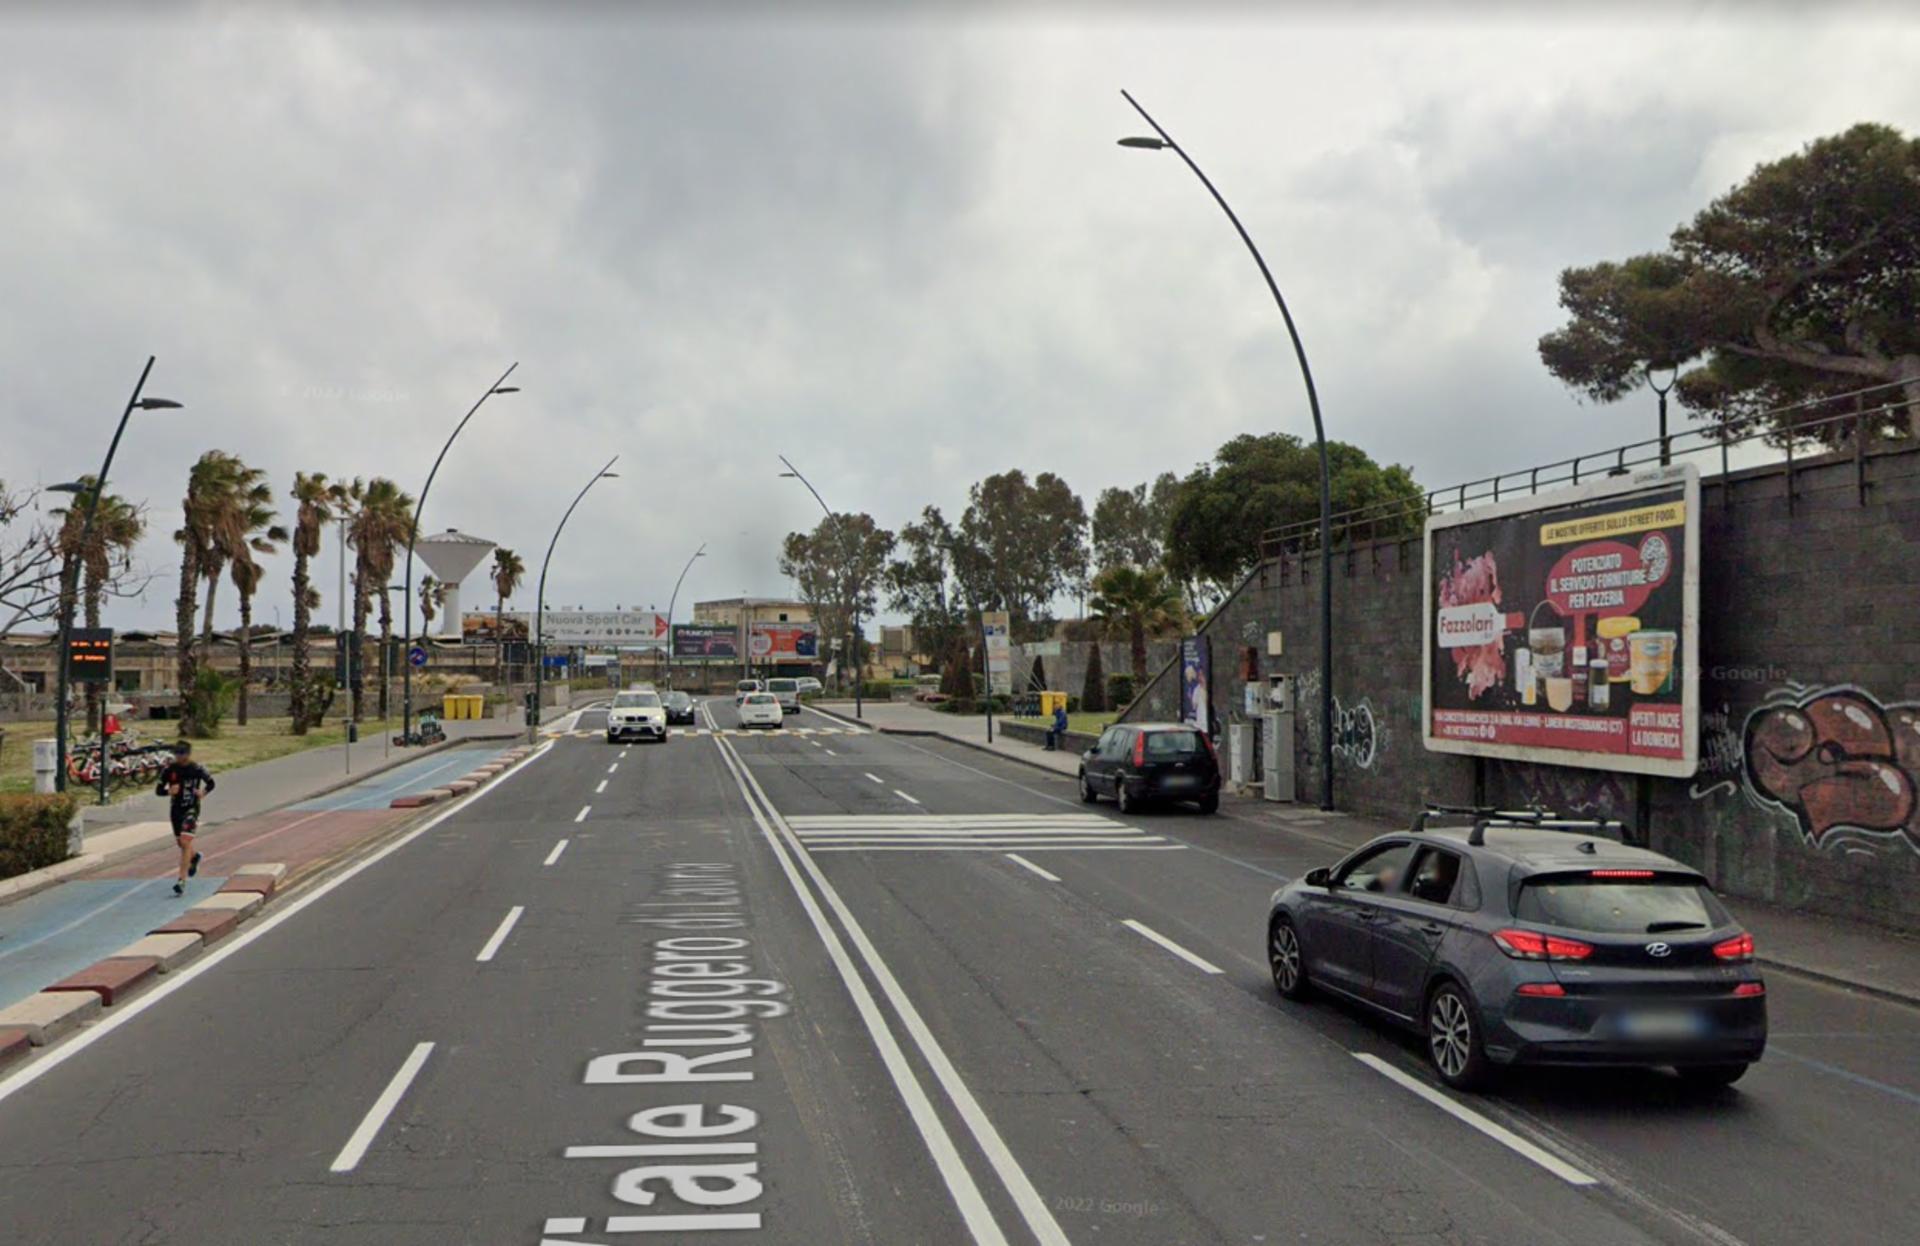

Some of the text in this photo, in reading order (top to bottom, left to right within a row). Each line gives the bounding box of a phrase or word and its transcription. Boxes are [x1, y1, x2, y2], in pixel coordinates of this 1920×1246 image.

[1629, 512, 1654, 525] STREET
[1571, 553, 1622, 573] POTENZIATO
[1560, 574, 1596, 591] SERVIZIO
[1597, 569, 1648, 588] FORNITURE
[1568, 590, 1624, 608] PER PIZZERIA
[546, 615, 643, 626] Nuova Sport Car
[1440, 613, 1494, 633] Fazzolari
[1631, 711, 1680, 728] APERTI ANCHE
[1632, 731, 1680, 748] LA DOMENICA
